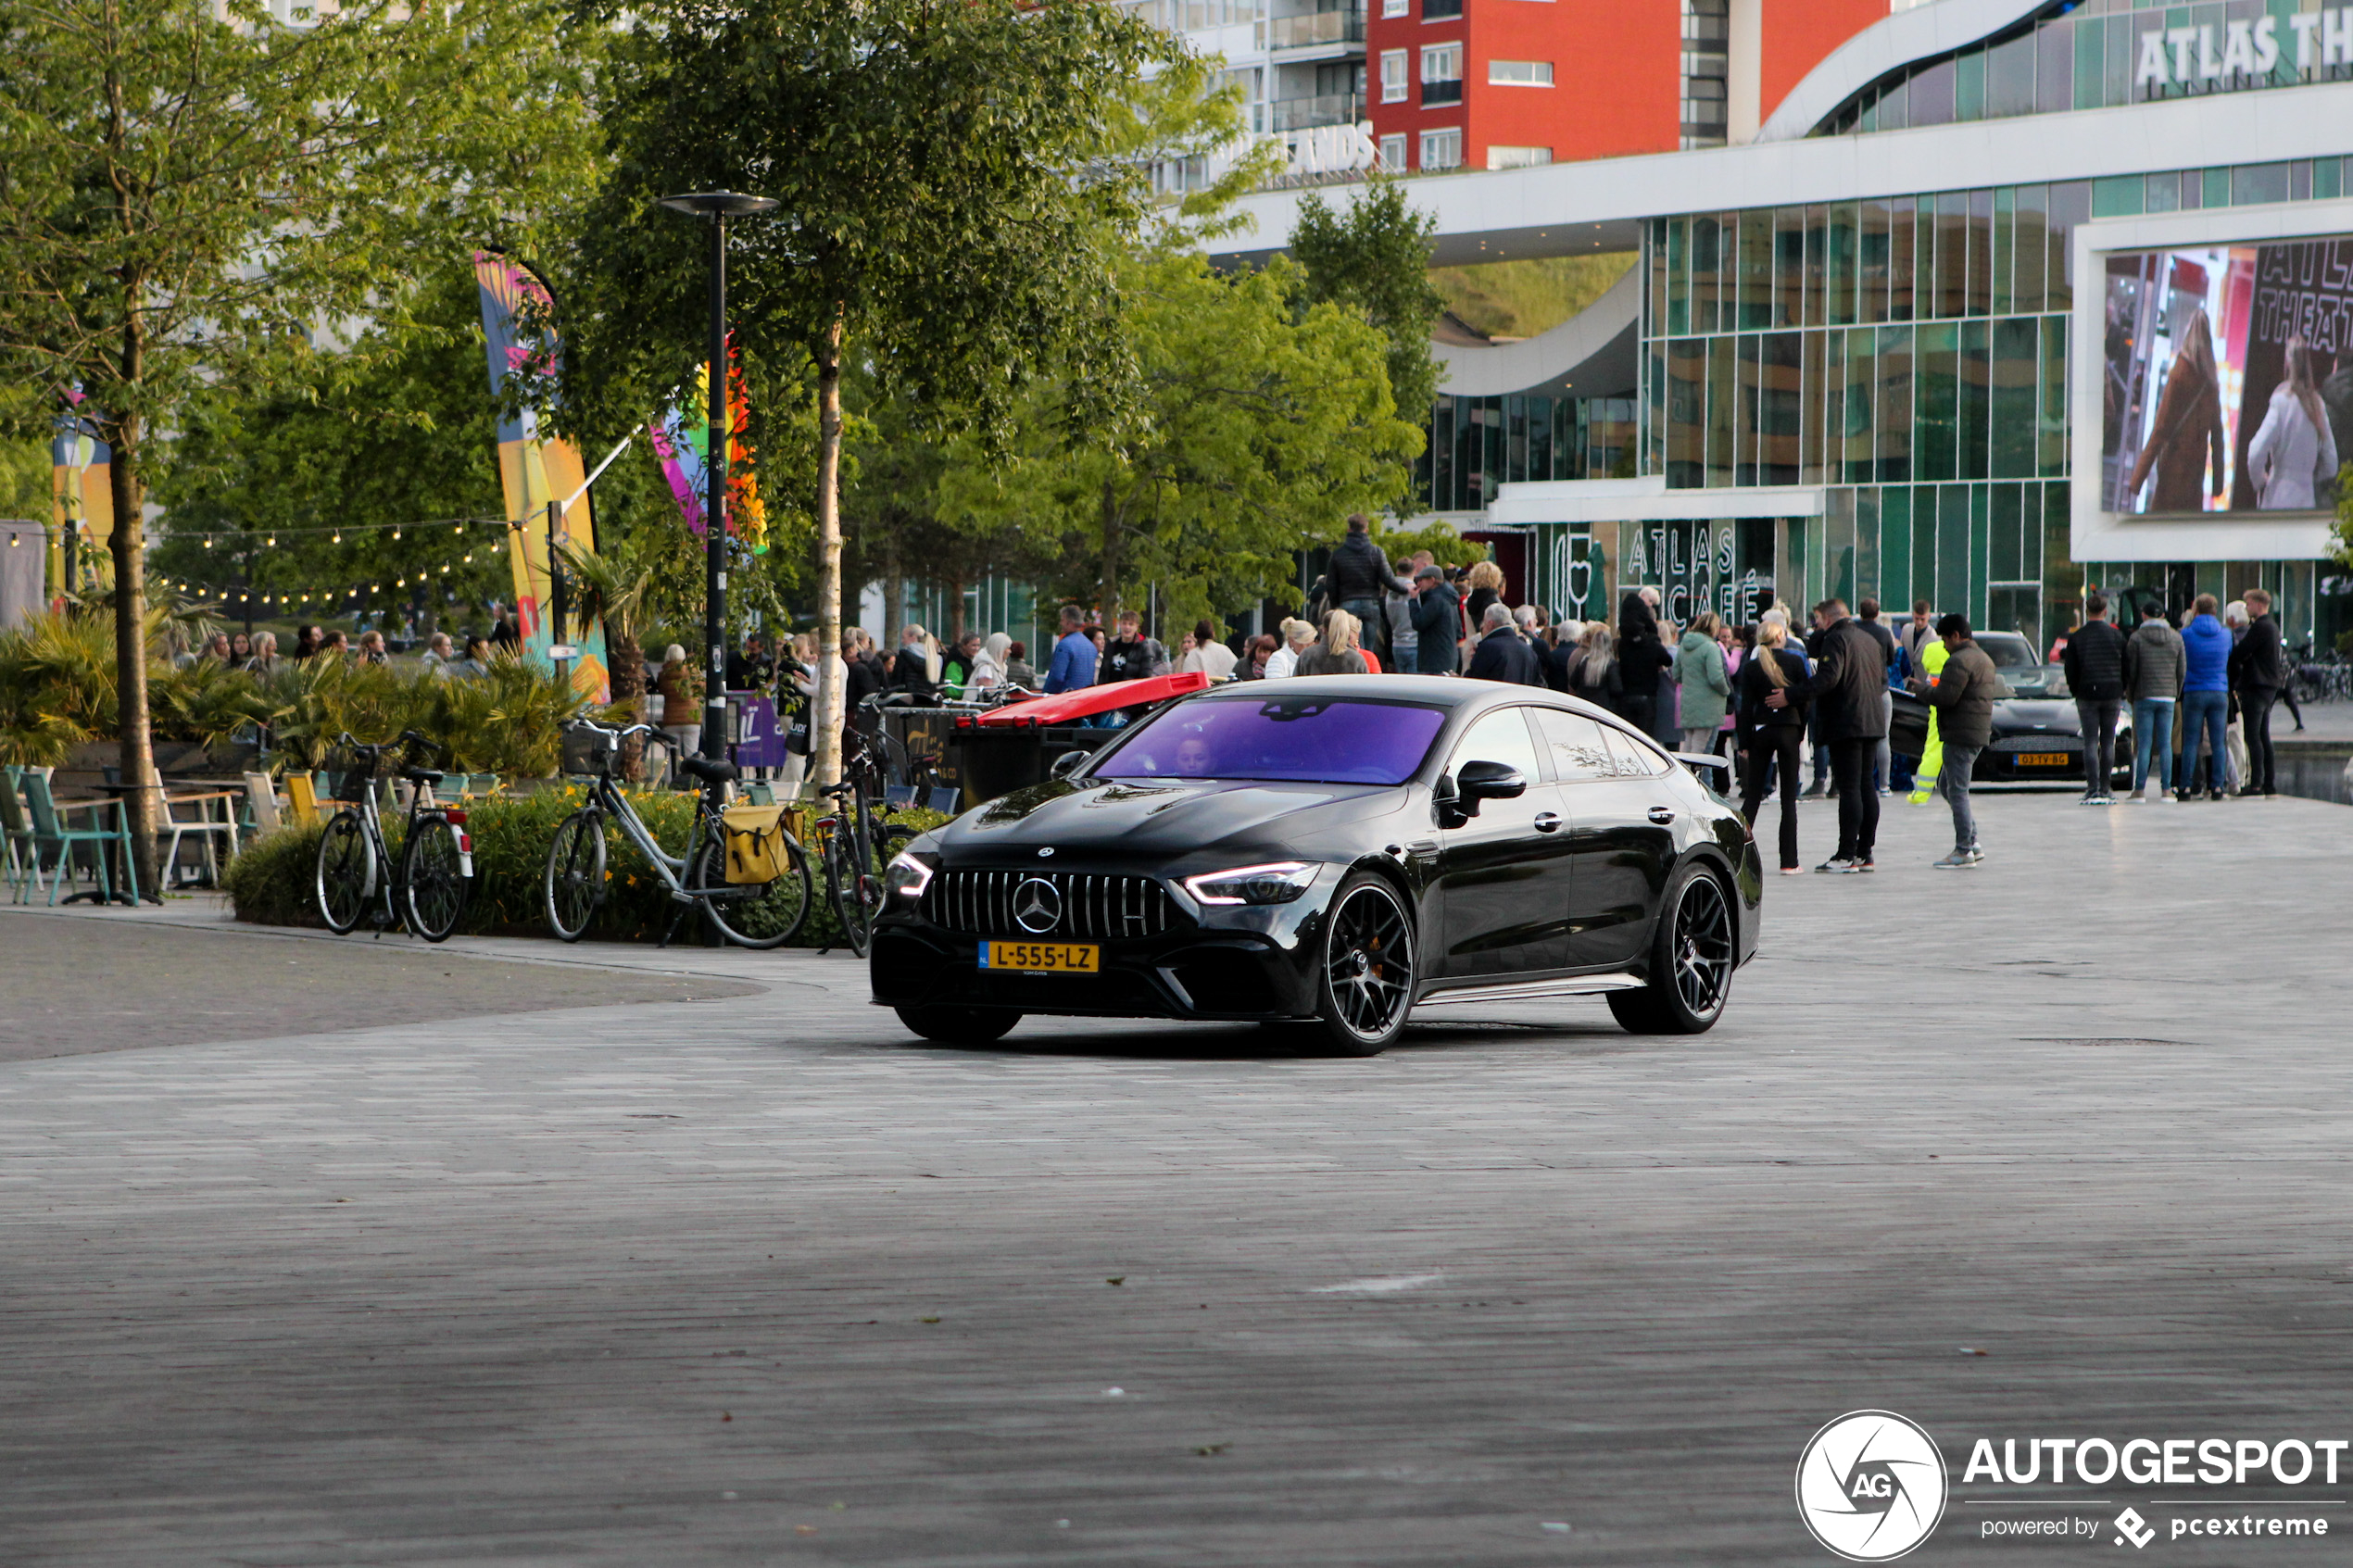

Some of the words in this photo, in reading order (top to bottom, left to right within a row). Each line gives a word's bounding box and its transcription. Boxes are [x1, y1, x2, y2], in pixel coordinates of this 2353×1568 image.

[2135, 15, 2279, 87] ATLAS
[1628, 526, 1734, 576] ATLAS
[1667, 568, 1761, 632] CAFÉ
[997, 945, 1091, 969] L-555-LZ
